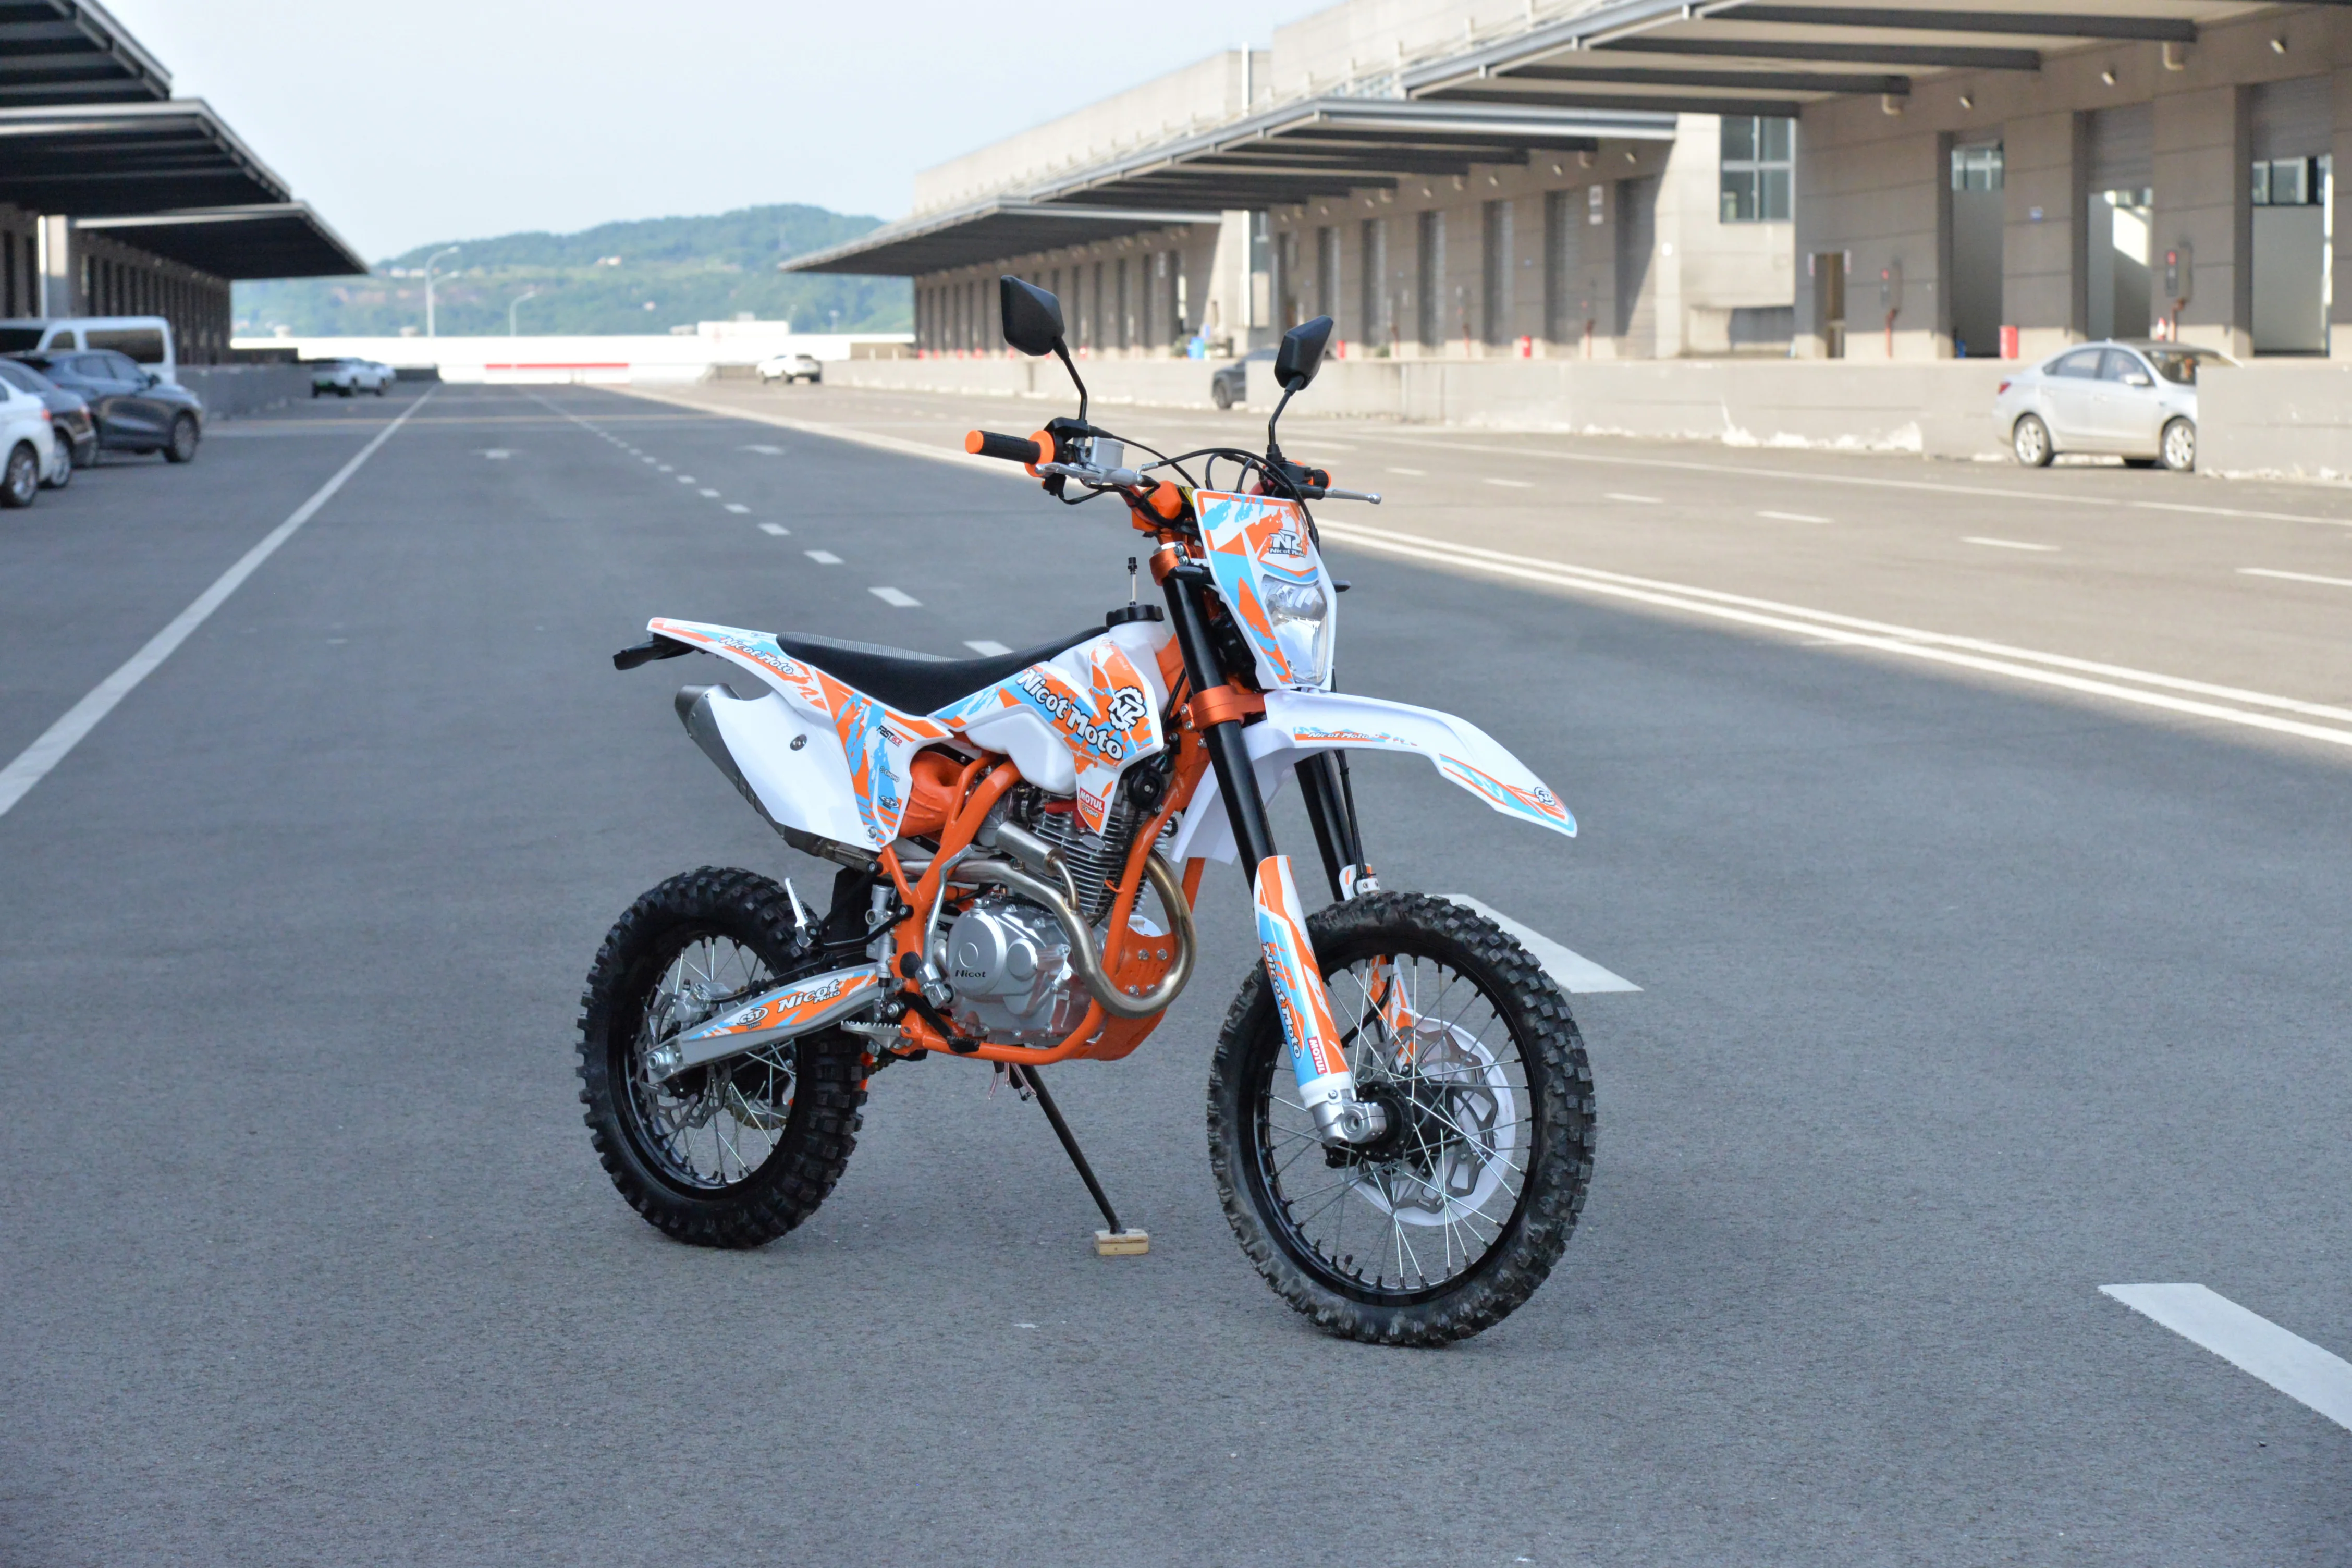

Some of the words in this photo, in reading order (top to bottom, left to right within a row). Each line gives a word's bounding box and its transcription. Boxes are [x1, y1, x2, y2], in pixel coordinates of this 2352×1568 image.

[719, 636, 763, 657] Nicot
[757, 653, 794, 675] Moto
[1015, 668, 1070, 720] Nicot
[1067, 703, 1123, 761] Moto
[1080, 790, 1102, 811] MOTUL
[955, 969, 986, 978] Nicot
[777, 979, 840, 1013] Nicot
[813, 990, 841, 1004] Moto
[1262, 942, 1286, 1005] Nicot
[1281, 1004, 1301, 1059] Moto
[739, 1011, 762, 1024] CST
[1309, 1039, 1326, 1075] MOTUL
